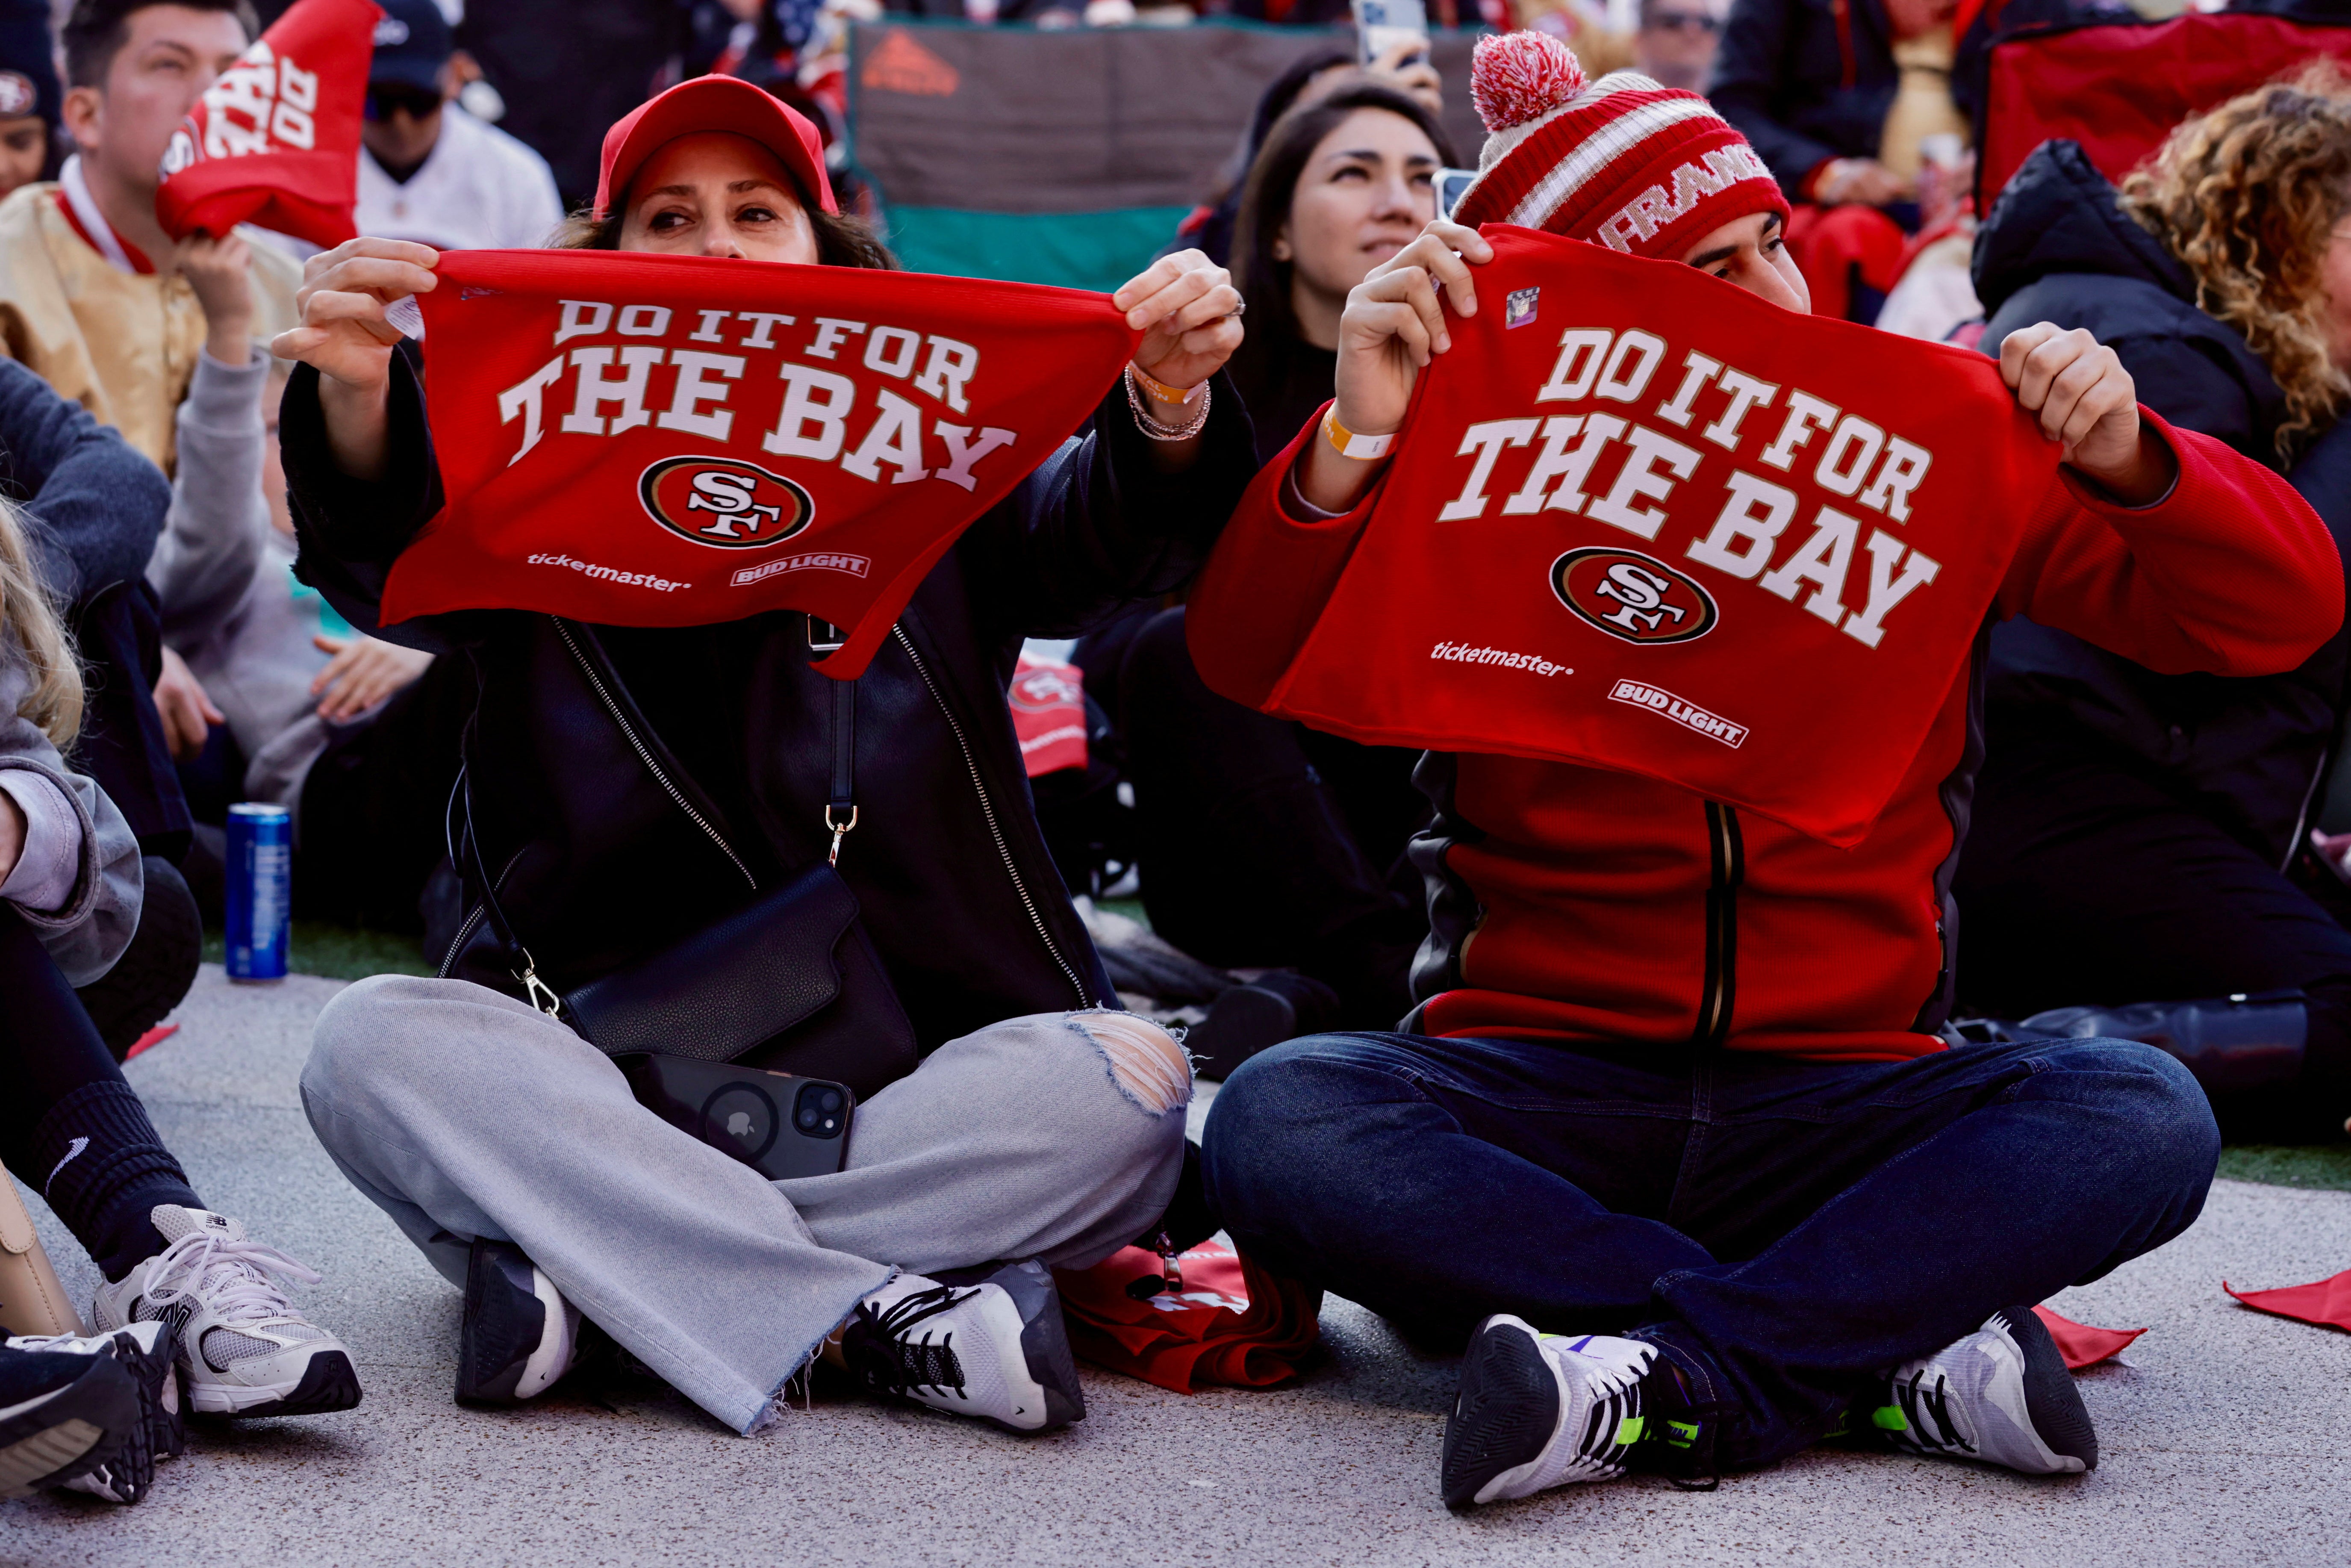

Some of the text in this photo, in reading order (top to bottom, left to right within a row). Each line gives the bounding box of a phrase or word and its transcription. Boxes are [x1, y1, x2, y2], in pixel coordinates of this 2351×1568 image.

[553, 299, 980, 417] DO IT FOR
[496, 344, 1017, 492] THE BAY
[1533, 326, 1934, 526] DO IT FOR
[687, 471, 781, 539] SF
[1434, 410, 1943, 651] THE BAY
[736, 561, 788, 583] BUD
[1595, 563, 1686, 633] SF
[1614, 683, 1669, 709] BUD
[206, 1224, 229, 1233] running
